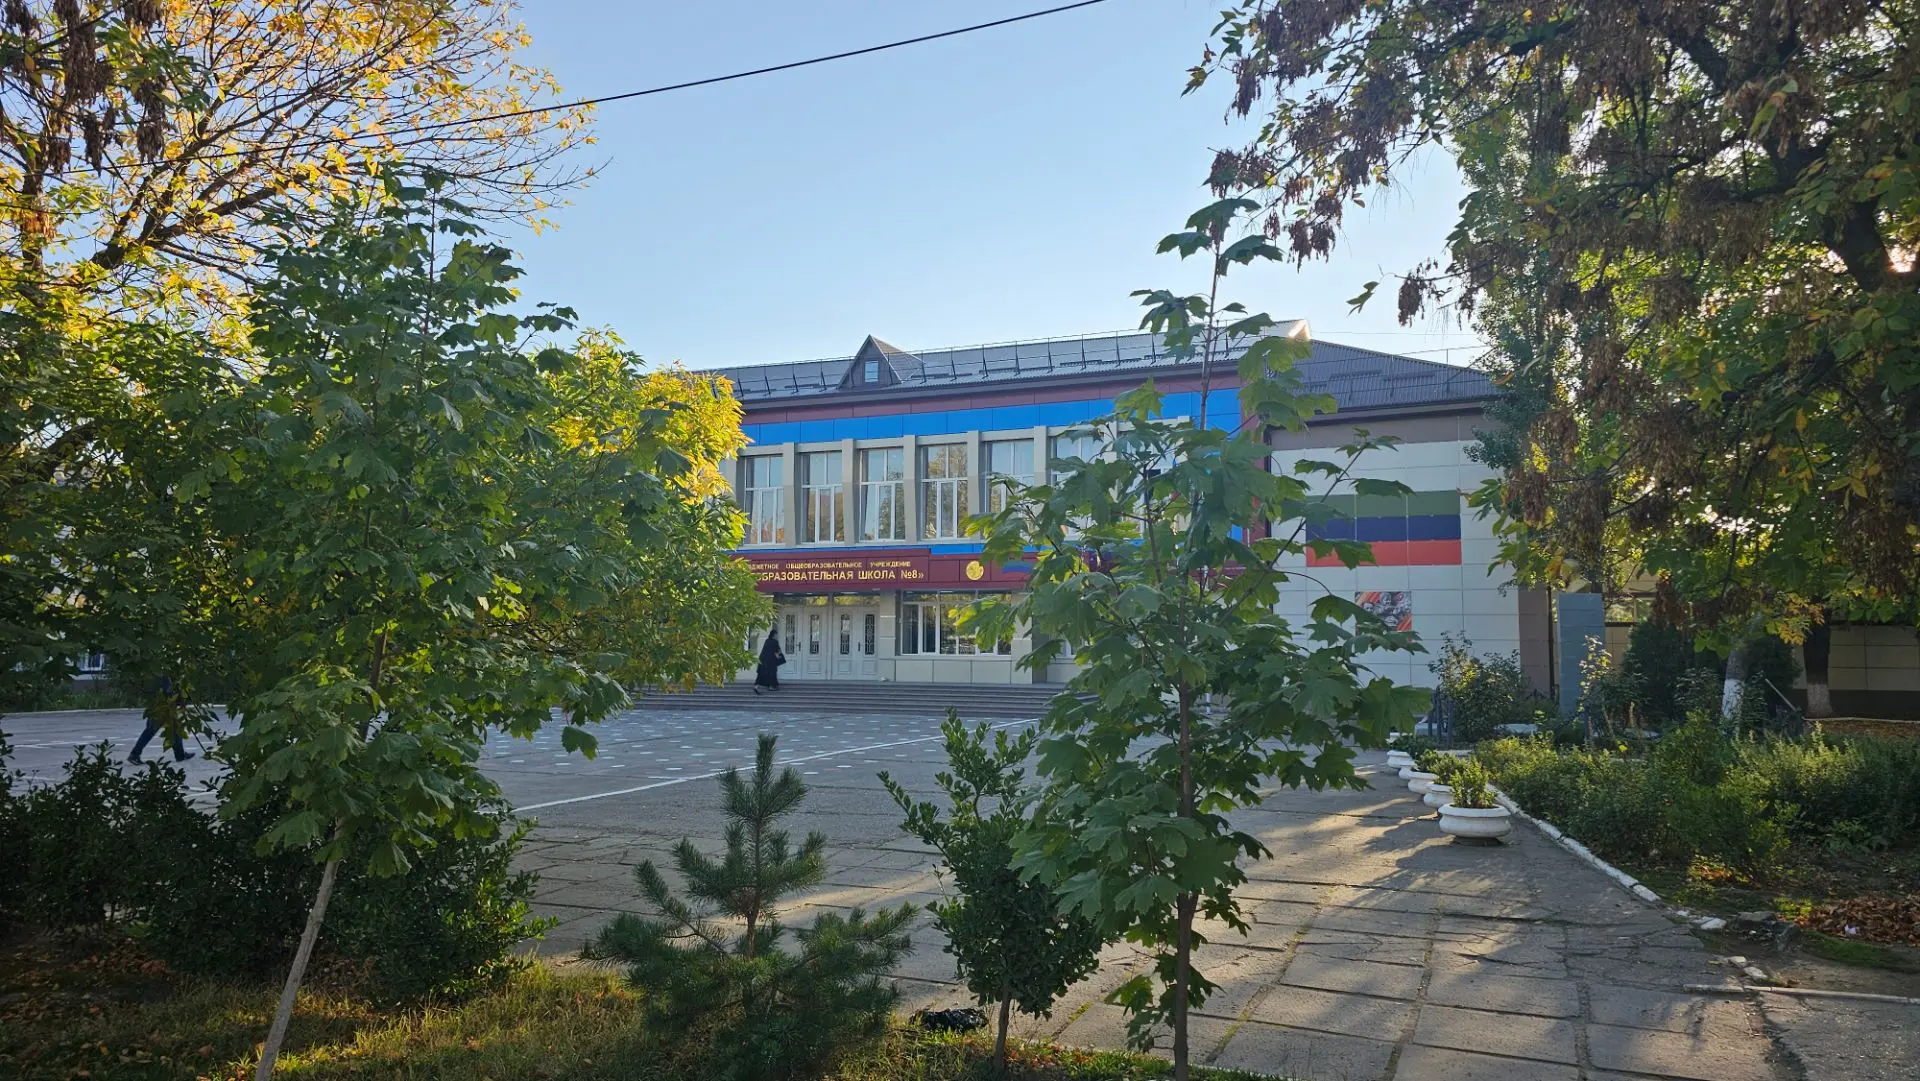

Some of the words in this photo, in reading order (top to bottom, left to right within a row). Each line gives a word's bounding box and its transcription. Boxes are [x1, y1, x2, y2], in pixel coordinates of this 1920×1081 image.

[785, 561, 863, 570] ОБЩЕОБРАЗОВАТЕЛЬНОЕ
[870, 560, 911, 569] УЧРЕЖДЕНИЕ
[858, 570, 896, 581] ШКОЛА
